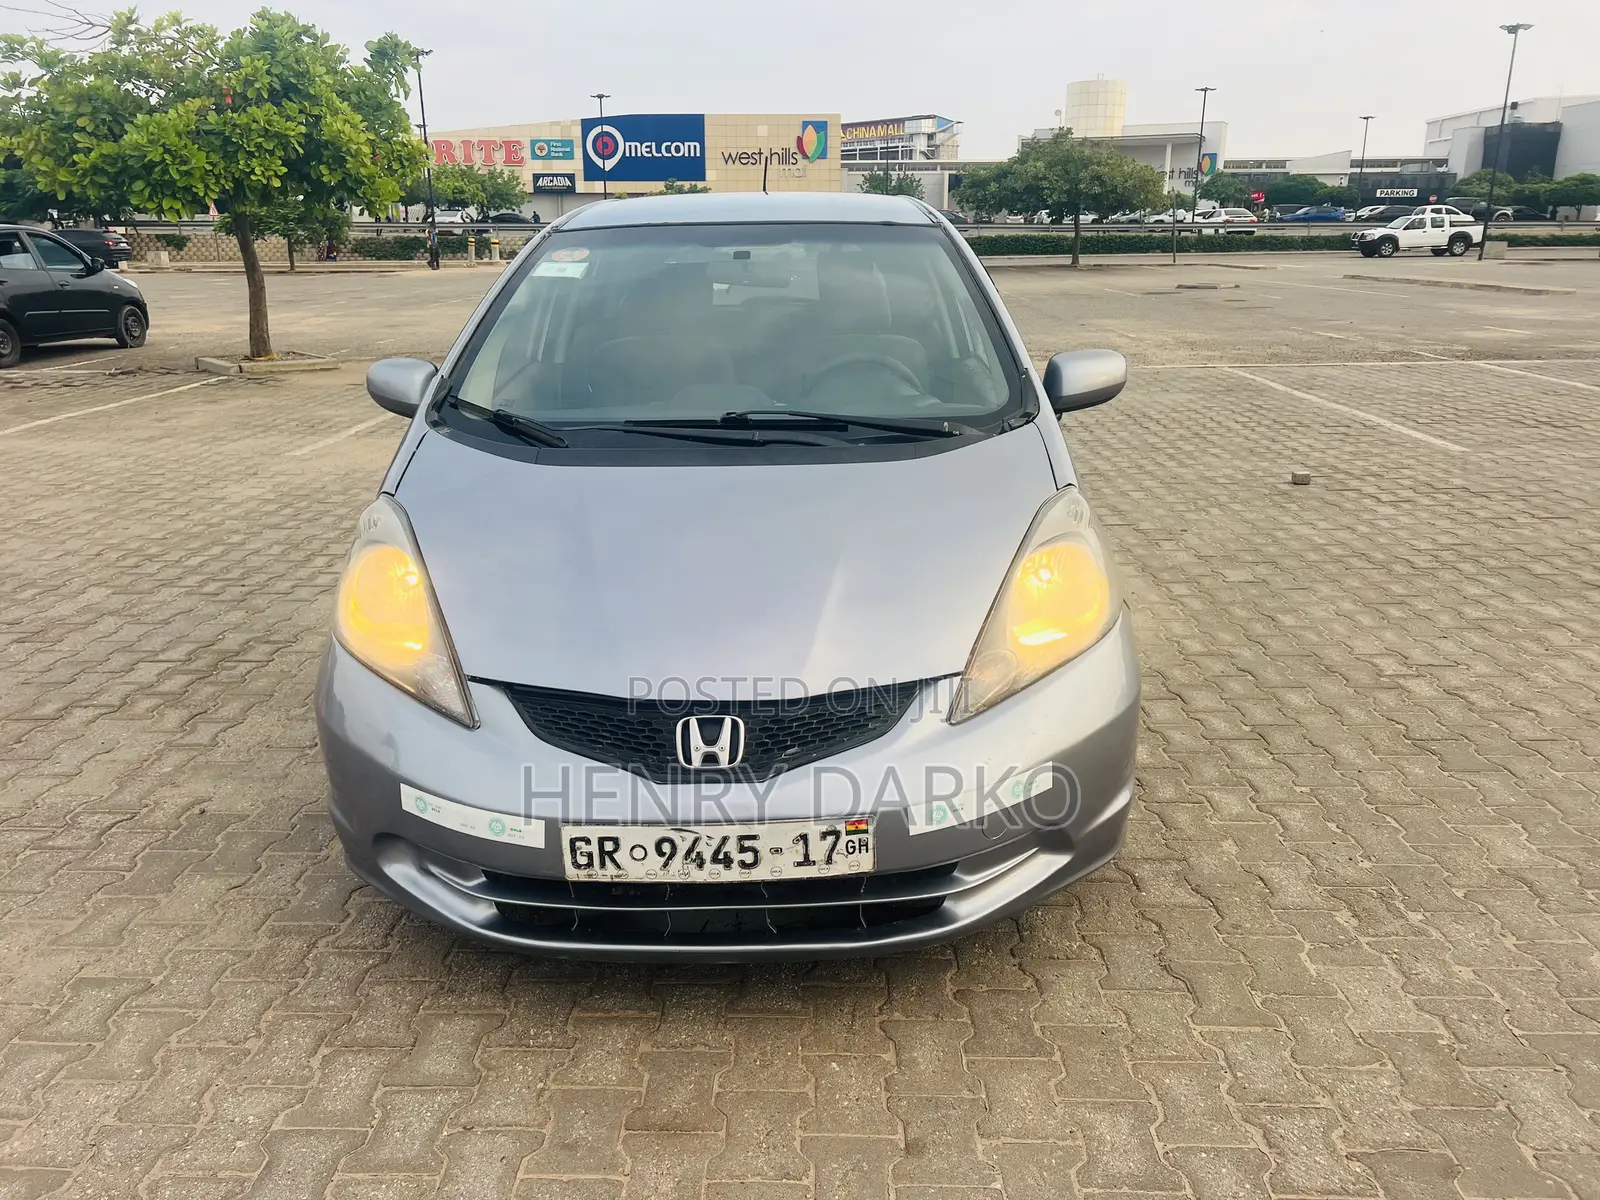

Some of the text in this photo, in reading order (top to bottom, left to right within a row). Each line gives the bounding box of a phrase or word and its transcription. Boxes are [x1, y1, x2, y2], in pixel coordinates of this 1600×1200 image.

[847, 126, 876, 139] CHINA
[877, 123, 904, 137] MALL
[429, 139, 525, 166] RITE
[721, 148, 798, 165] west hills
[536, 176, 572, 187] ARCADIA
[1379, 189, 1415, 197] PARKING
[569, 836, 624, 870] GR
[845, 838, 869, 855] GH
